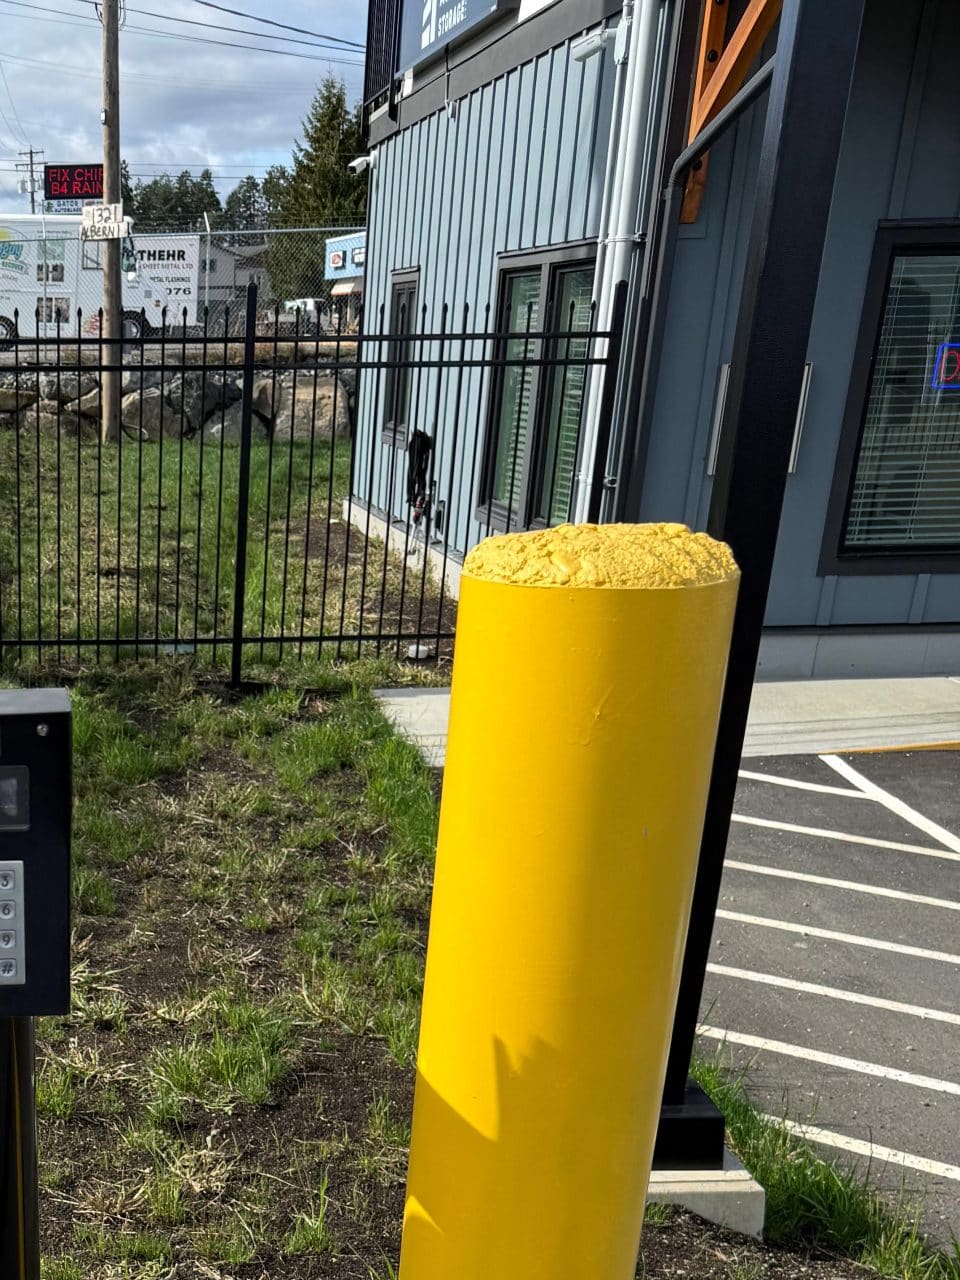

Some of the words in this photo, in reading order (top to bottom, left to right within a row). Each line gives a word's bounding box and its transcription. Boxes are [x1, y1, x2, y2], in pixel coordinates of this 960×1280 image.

[48, 169, 69, 181] FIX
[51, 182, 67, 194] B4
[93, 206, 117, 224] 1321
[137, 250, 186, 261] THEHR
